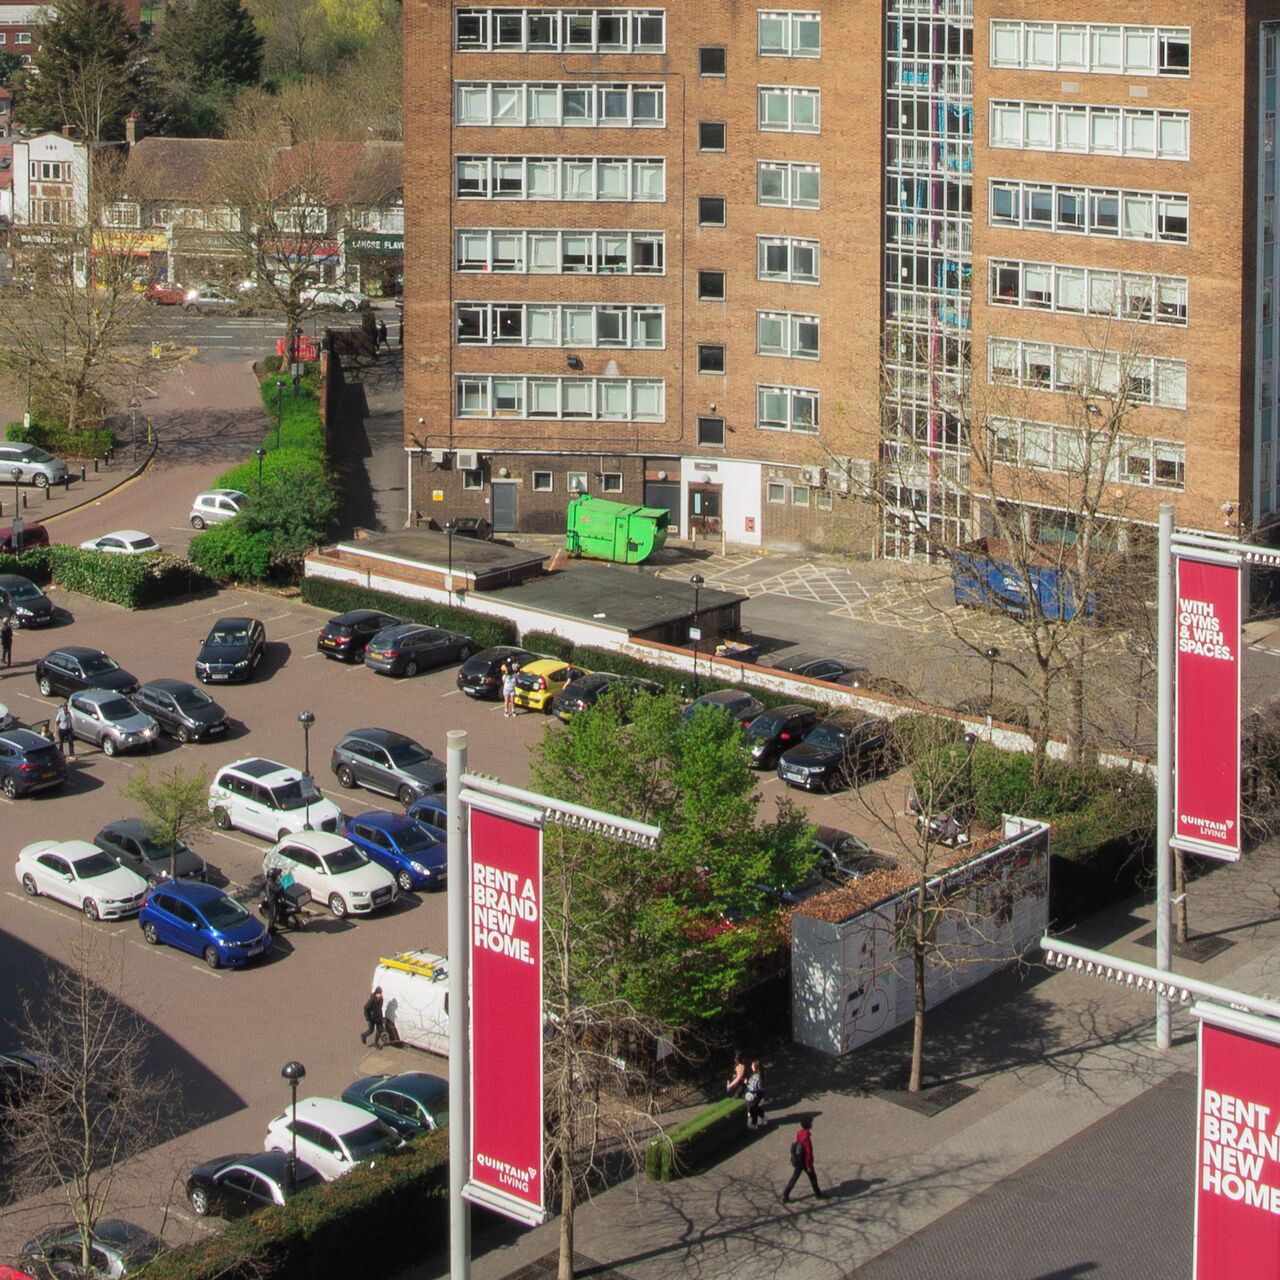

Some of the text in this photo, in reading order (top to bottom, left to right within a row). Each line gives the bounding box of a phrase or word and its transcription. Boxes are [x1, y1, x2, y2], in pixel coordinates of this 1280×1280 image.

[1179, 598, 1214, 617] WITH
[1179, 612, 1219, 631] GYMS
[1180, 625, 1223, 645] & WFH
[1179, 639, 1234, 661] SPACES.
[1181, 815, 1227, 831] QUINTAIN
[1200, 827, 1227, 839] LIVING
[474, 862, 536, 901] RENT A
[474, 884, 538, 921] BRAND
[474, 904, 515, 936] NEW
[475, 926, 535, 965] HOME.
[1205, 1088, 1270, 1130] RENT
[477, 1154, 529, 1182] QUINTAIN
[1203, 1140, 1264, 1181] NEW
[499, 1172, 529, 1192] LIVING
